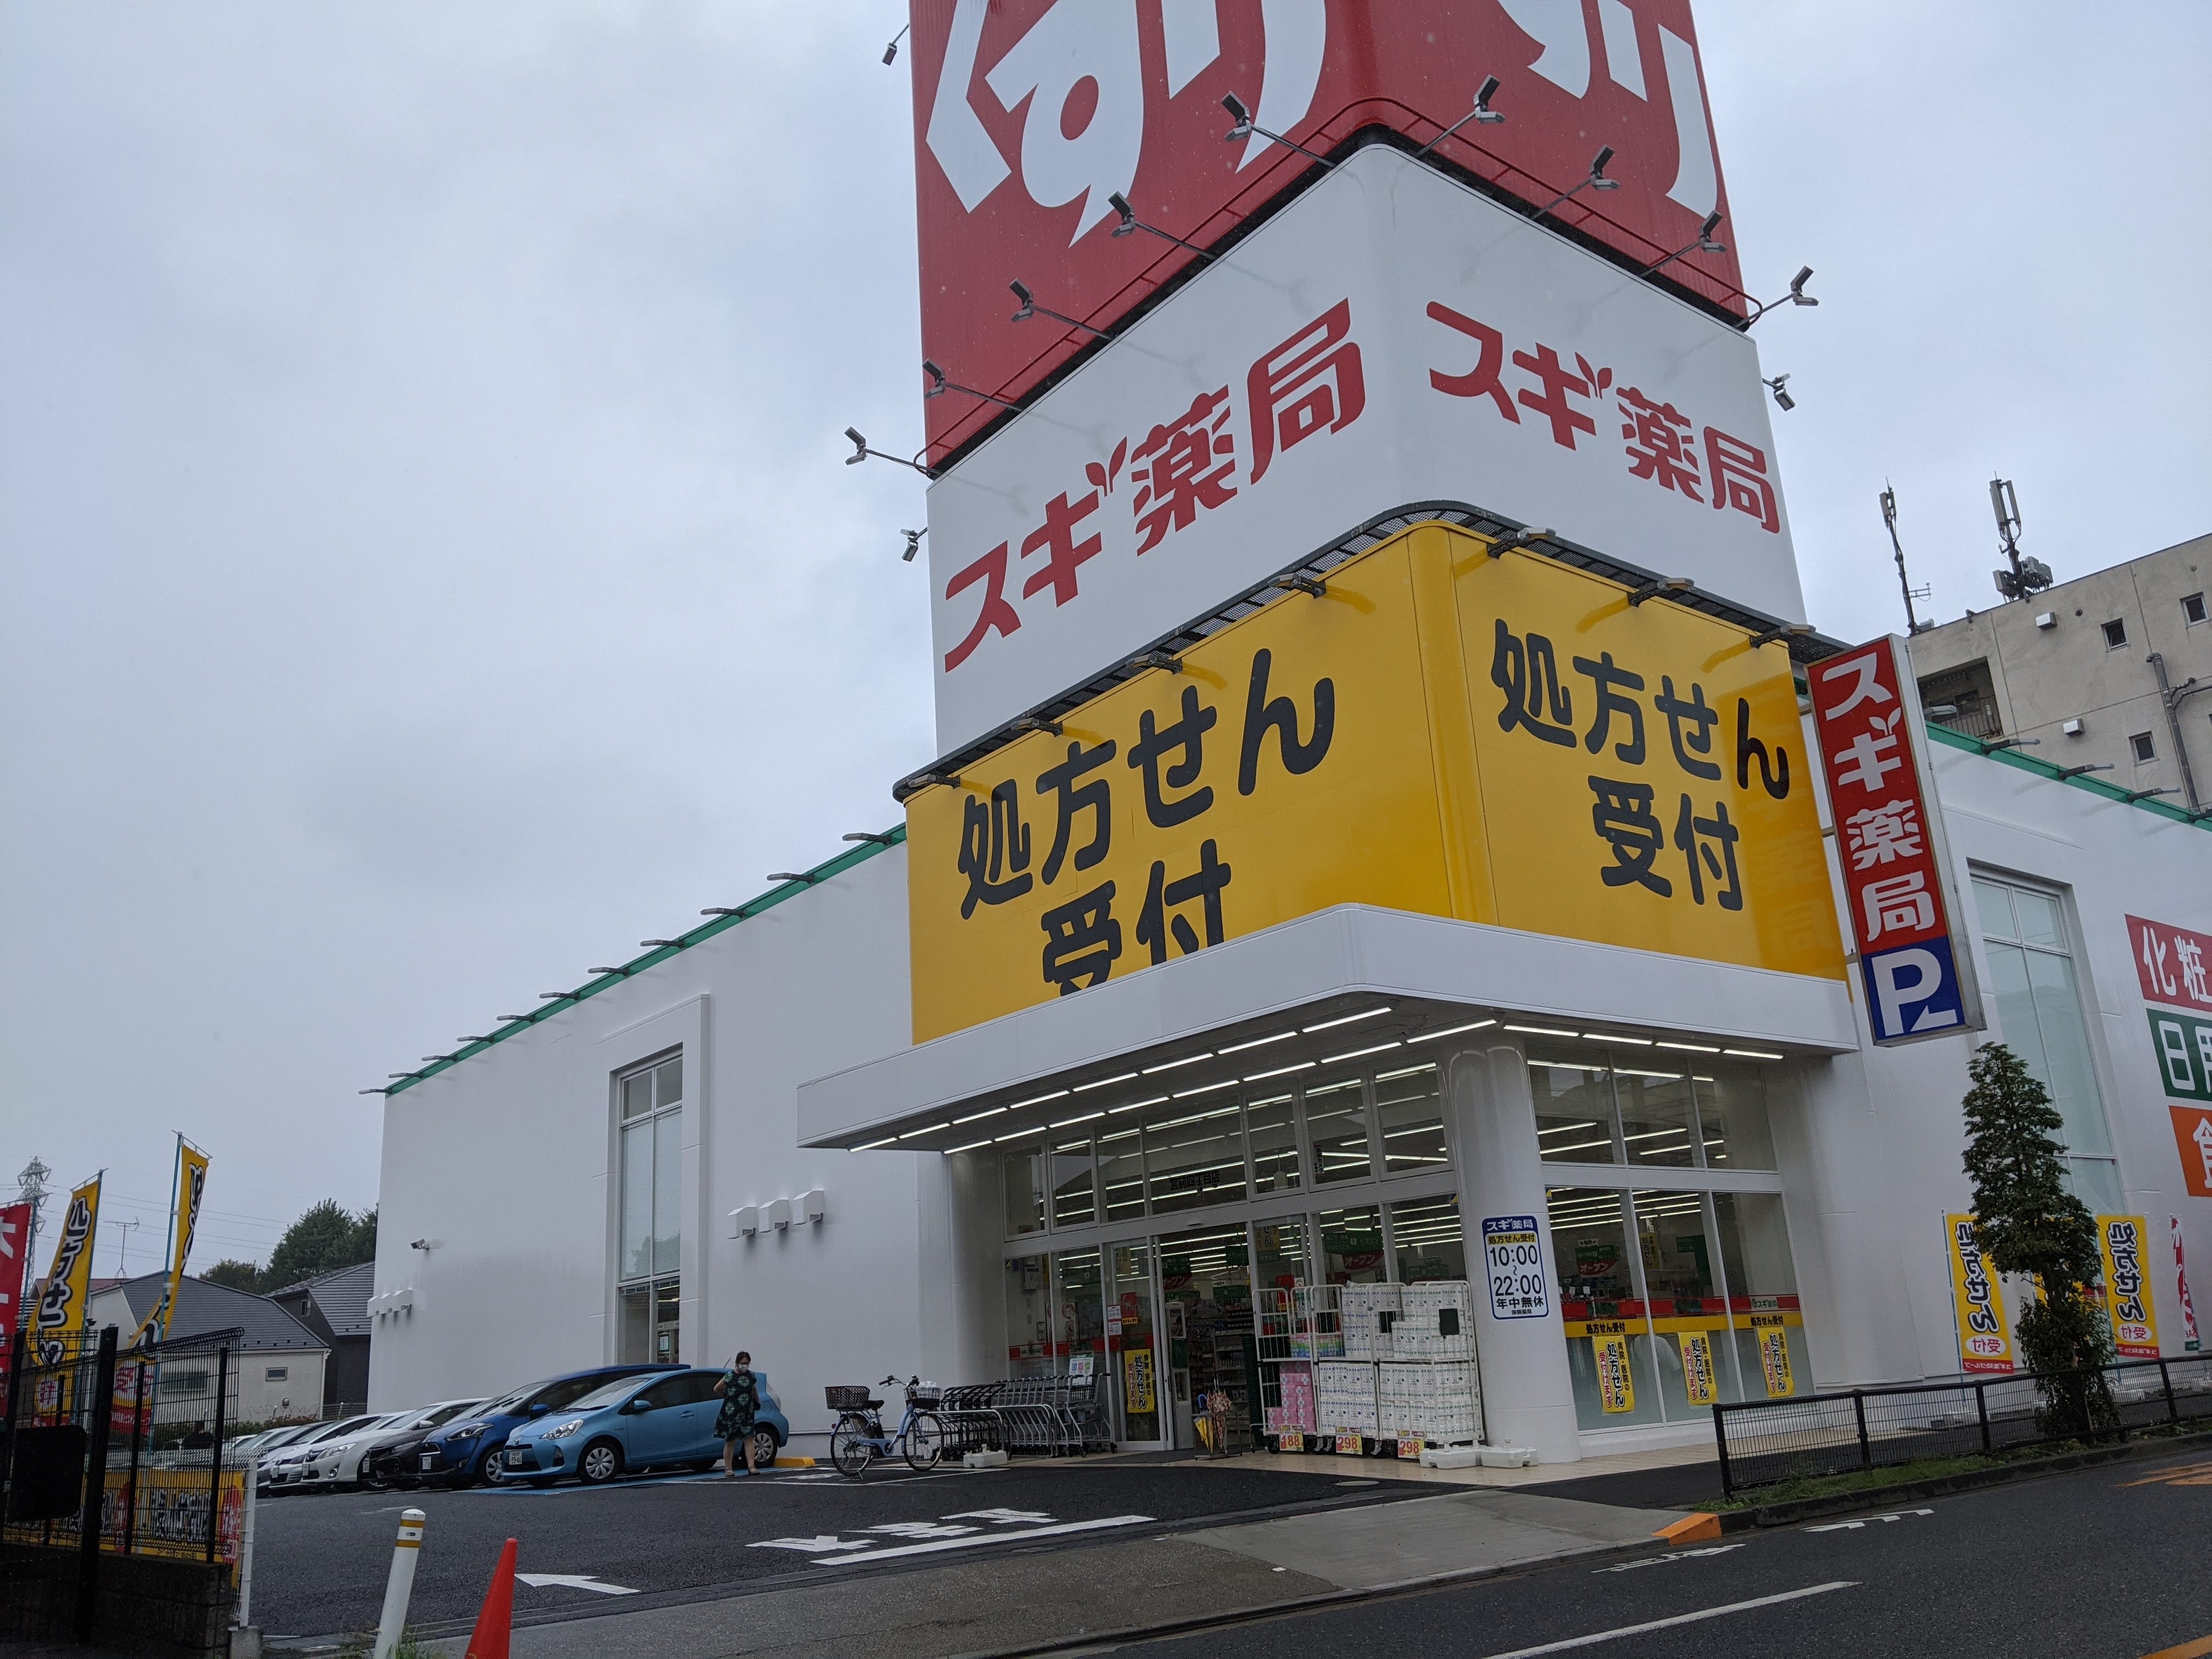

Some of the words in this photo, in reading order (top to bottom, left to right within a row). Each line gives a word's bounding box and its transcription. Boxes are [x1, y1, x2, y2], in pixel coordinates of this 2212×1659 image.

[1426, 301, 1780, 534] スギ薬局
[945, 297, 1364, 672] スギ薬局
[1489, 618, 1789, 800] 処方せん
[957, 648, 1335, 921] 処方せん
[1822, 652, 1935, 942] スギ薬局
[1589, 775, 1743, 912] 受付
[1041, 838, 1232, 996] 受付
[1871, 948, 1942, 1036] P
[1487, 1218, 1533, 1231] スギ薬局
[1488, 1233, 1535, 1244] 処方せん受付
[1490, 1245, 1538, 1267] 10:00
[1494, 1274, 1542, 1296] 22:00
[1496, 1296, 1544, 1310] 年中無休
[1586, 1322, 1626, 1334] 処方せん受付
[1751, 1316, 1783, 1327] 処方せん受付
[1134, 1355, 1147, 1409] 処方せん
[1598, 1351, 1612, 1408] 受付けます
[1607, 1342, 1624, 1407] 処方せん
[1683, 1346, 1698, 1400] 受付けます
[1691, 1338, 1708, 1400] 処方せん
[1769, 1333, 1786, 1392] 処方せん
[1282, 1435, 1300, 1447] 188
[1338, 1436, 1358, 1449] 298
[1400, 1440, 1420, 1454] 298
